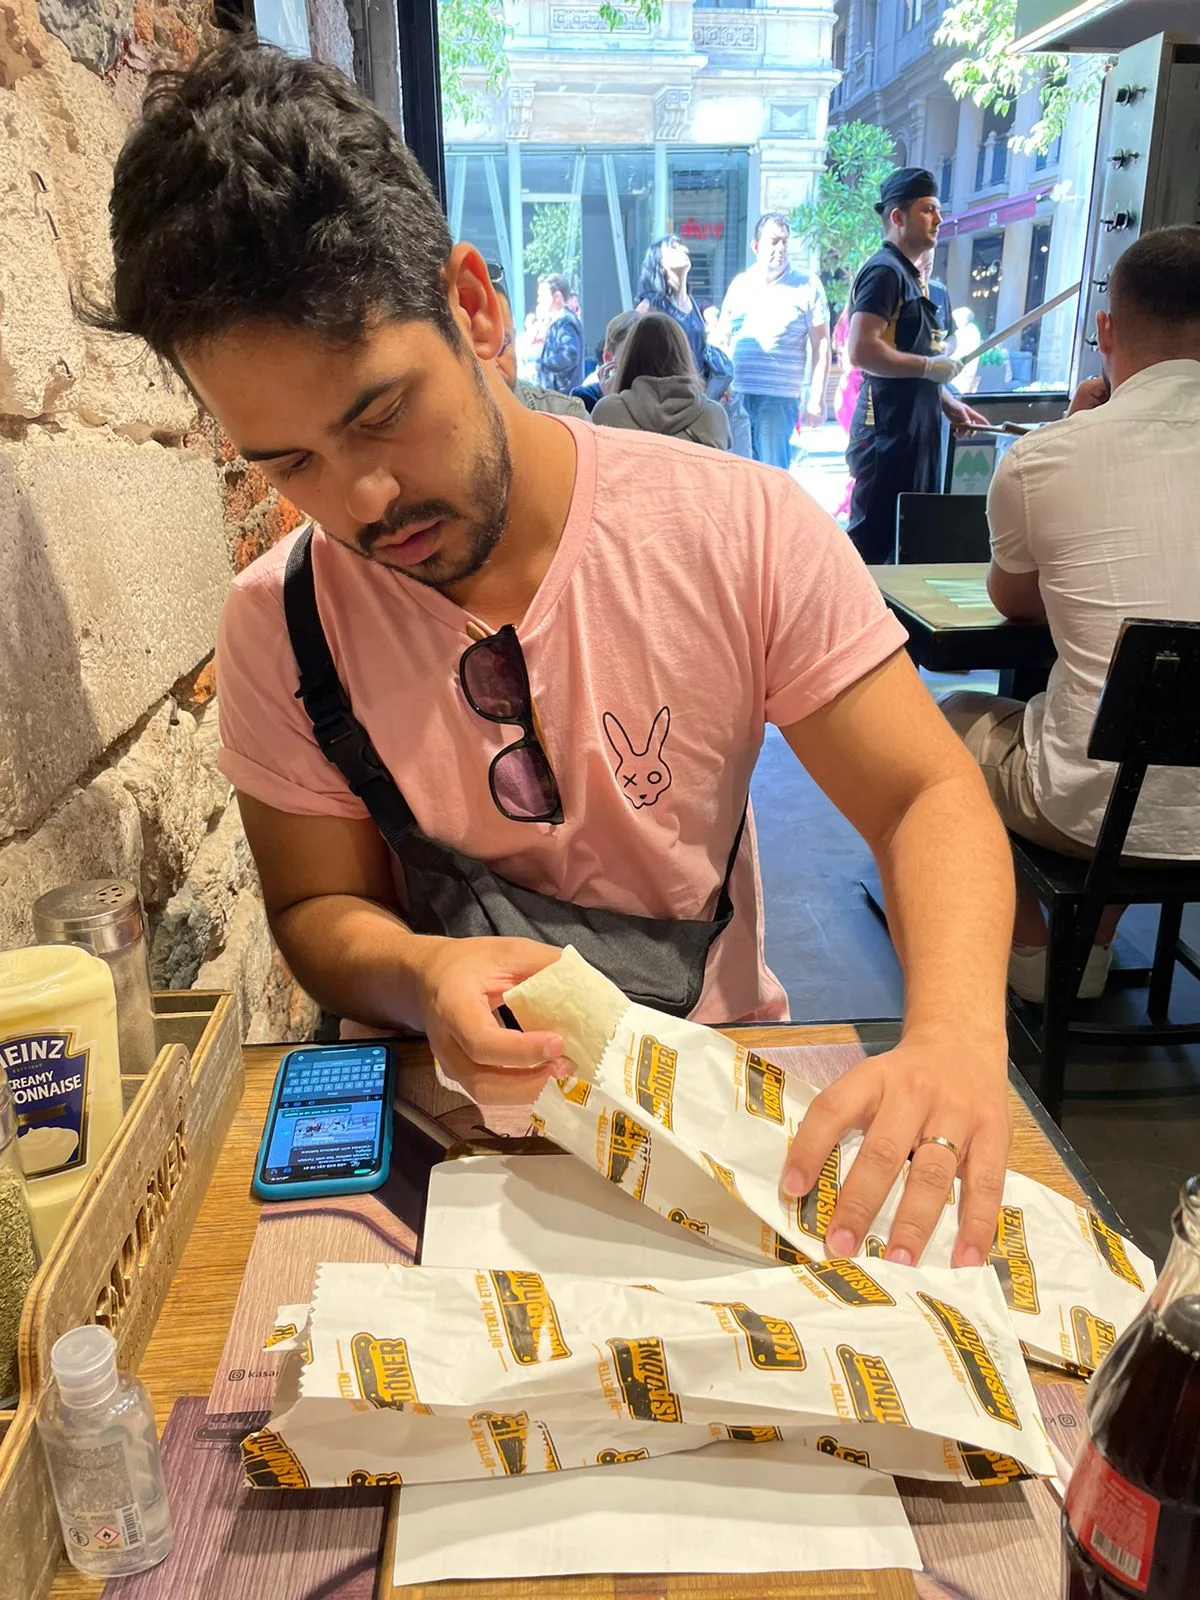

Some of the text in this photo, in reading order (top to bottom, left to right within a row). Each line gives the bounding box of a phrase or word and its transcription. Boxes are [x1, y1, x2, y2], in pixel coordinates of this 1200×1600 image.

[13, 1074, 82, 1105] ONNAISE
[763, 1072, 784, 1121] KASAP
[1002, 1207, 1035, 1309] KASAP DÖNER
[836, 1265, 889, 1301] KASAP
[974, 1354, 1017, 1420] KASAP
